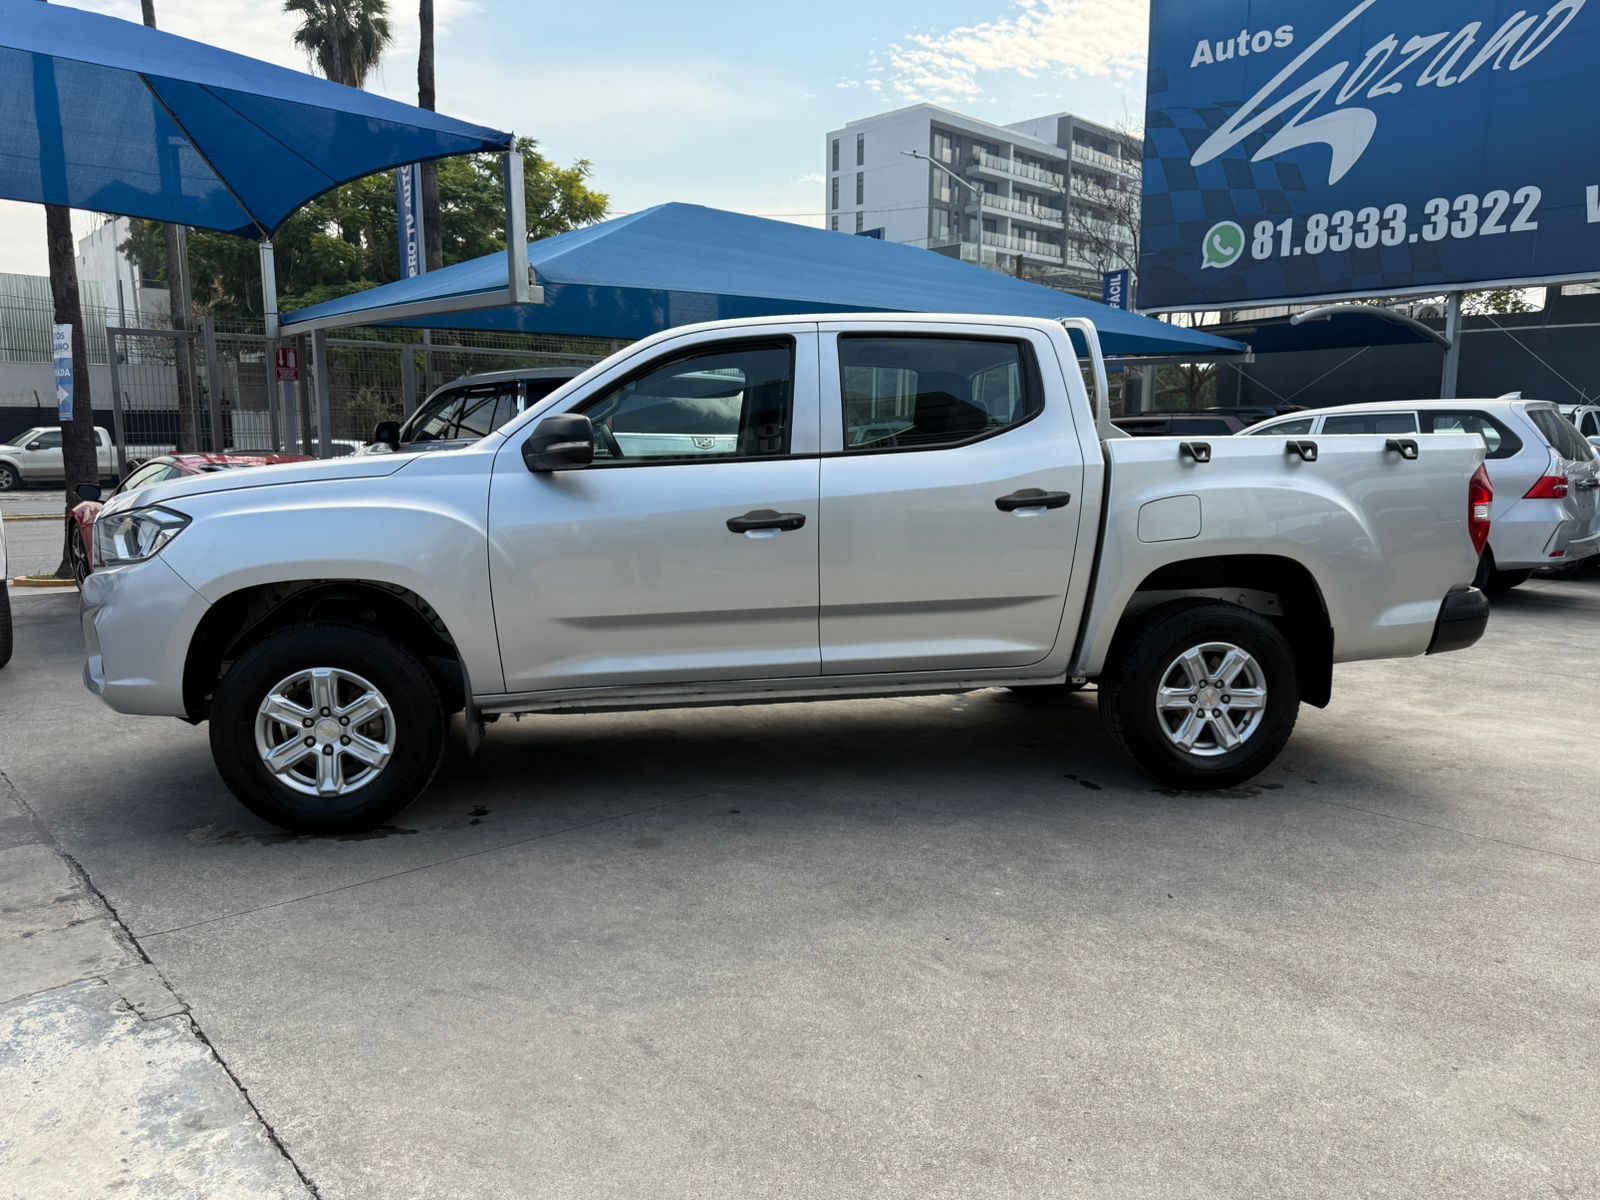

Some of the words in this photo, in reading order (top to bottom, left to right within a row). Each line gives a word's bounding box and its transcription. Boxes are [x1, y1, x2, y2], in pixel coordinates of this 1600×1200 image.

[1189, 24, 1294, 68] Autos
[406, 214, 415, 238] TU
[1251, 185, 1543, 260] 81.8333.3322
[1107, 274, 1121, 309] FÁCIL
